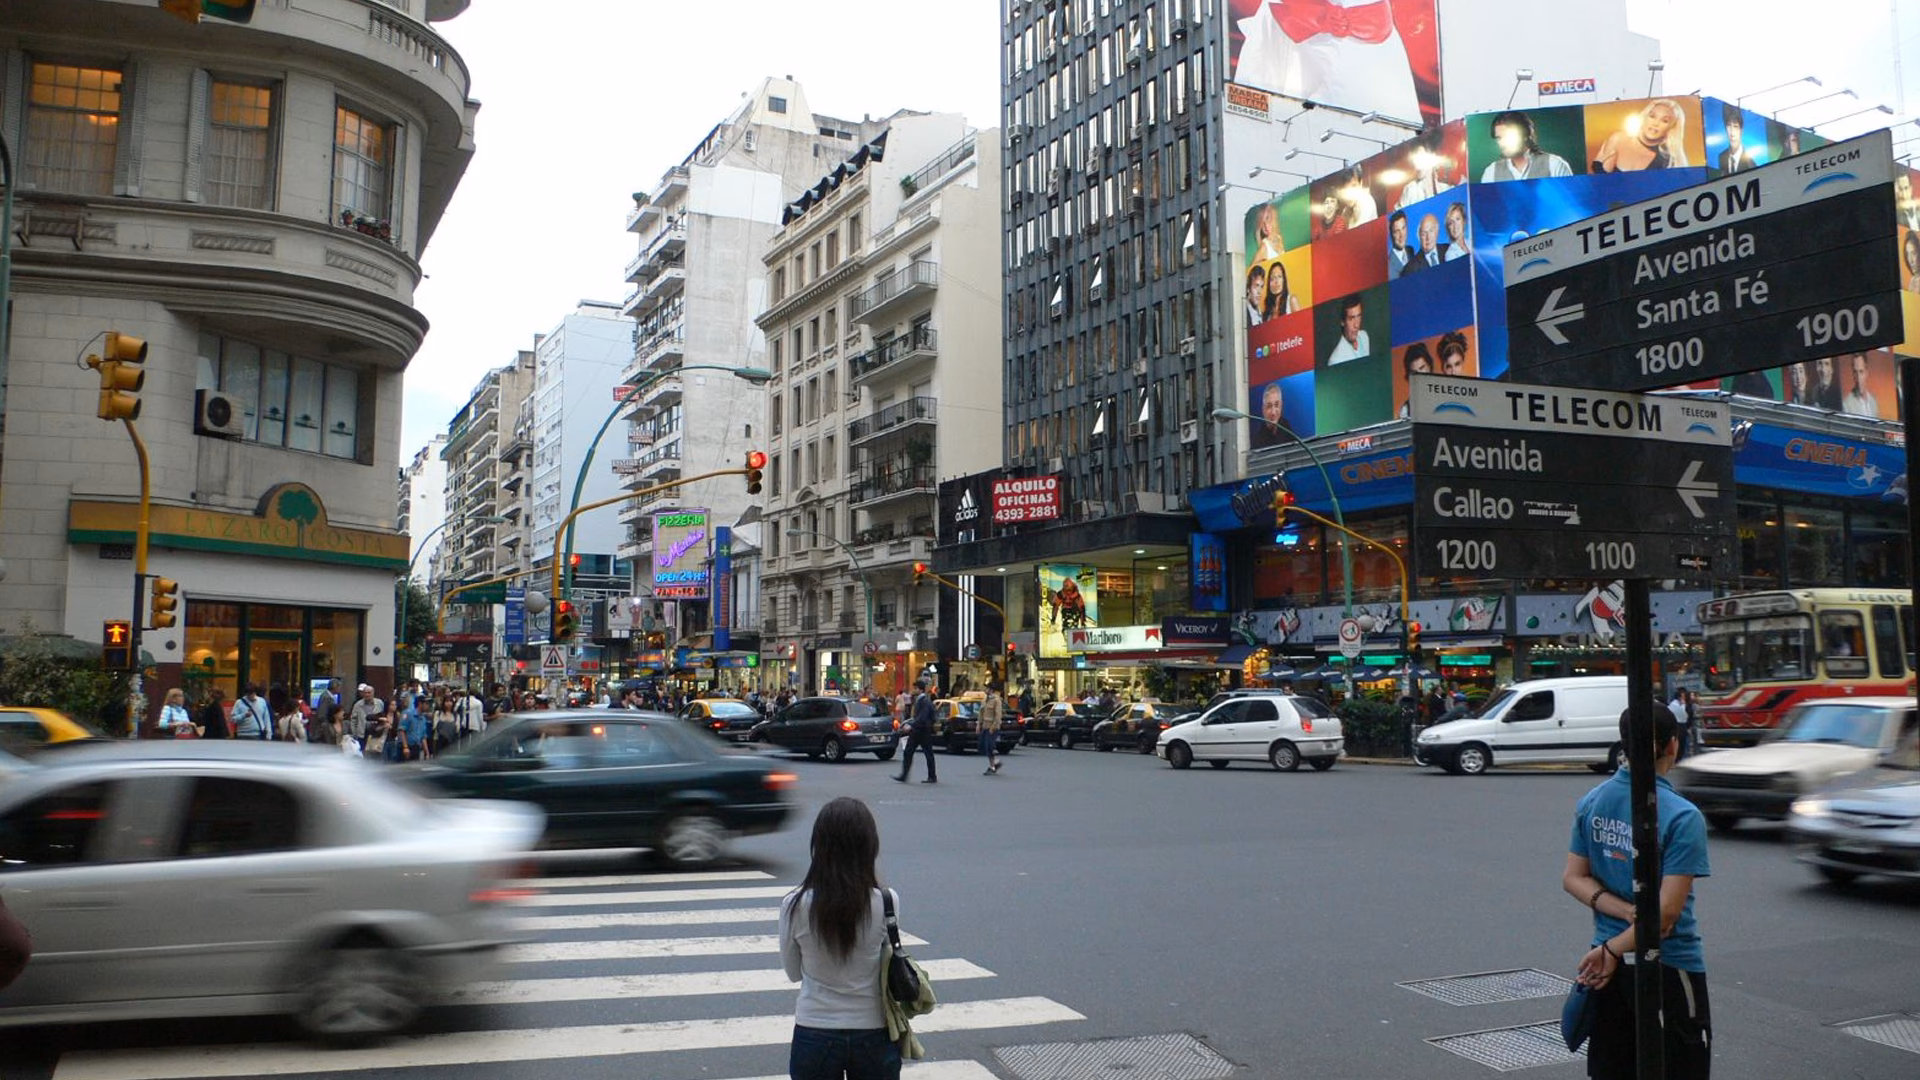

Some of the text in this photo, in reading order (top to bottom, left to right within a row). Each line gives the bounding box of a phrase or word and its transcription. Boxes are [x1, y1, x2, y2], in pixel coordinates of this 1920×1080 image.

[1229, 85, 1266, 101] MARCA
[1555, 80, 1593, 93] MECA
[1228, 94, 1269, 112] URBANA
[1795, 149, 1861, 175] TELECOM
[1576, 178, 1761, 255] TELECOM
[1513, 239, 1553, 258] TELECOM
[1634, 228, 1755, 286] Avenida
[1637, 270, 1769, 330] Santa Fé
[1636, 304, 1879, 376] 1800 1900
[1427, 384, 1717, 432] TELECOM TELECOM TELECOM
[1347, 437, 1371, 451] MECA
[1433, 437, 1543, 473] Avenida
[1784, 437, 1868, 468] CINEMA
[994, 478, 1057, 494] ALQUILO
[998, 493, 1054, 507] OFICINAS
[1433, 487, 1514, 520] Callao
[658, 514, 705, 528] PIZZERIA
[995, 505, 1057, 521] 4393-2881
[311, 526, 383, 554] COSTA
[1436, 540, 1636, 571] 1200 1100
[1085, 630, 1122, 646] Marlboro
[1175, 623, 1209, 635] VICEROY
